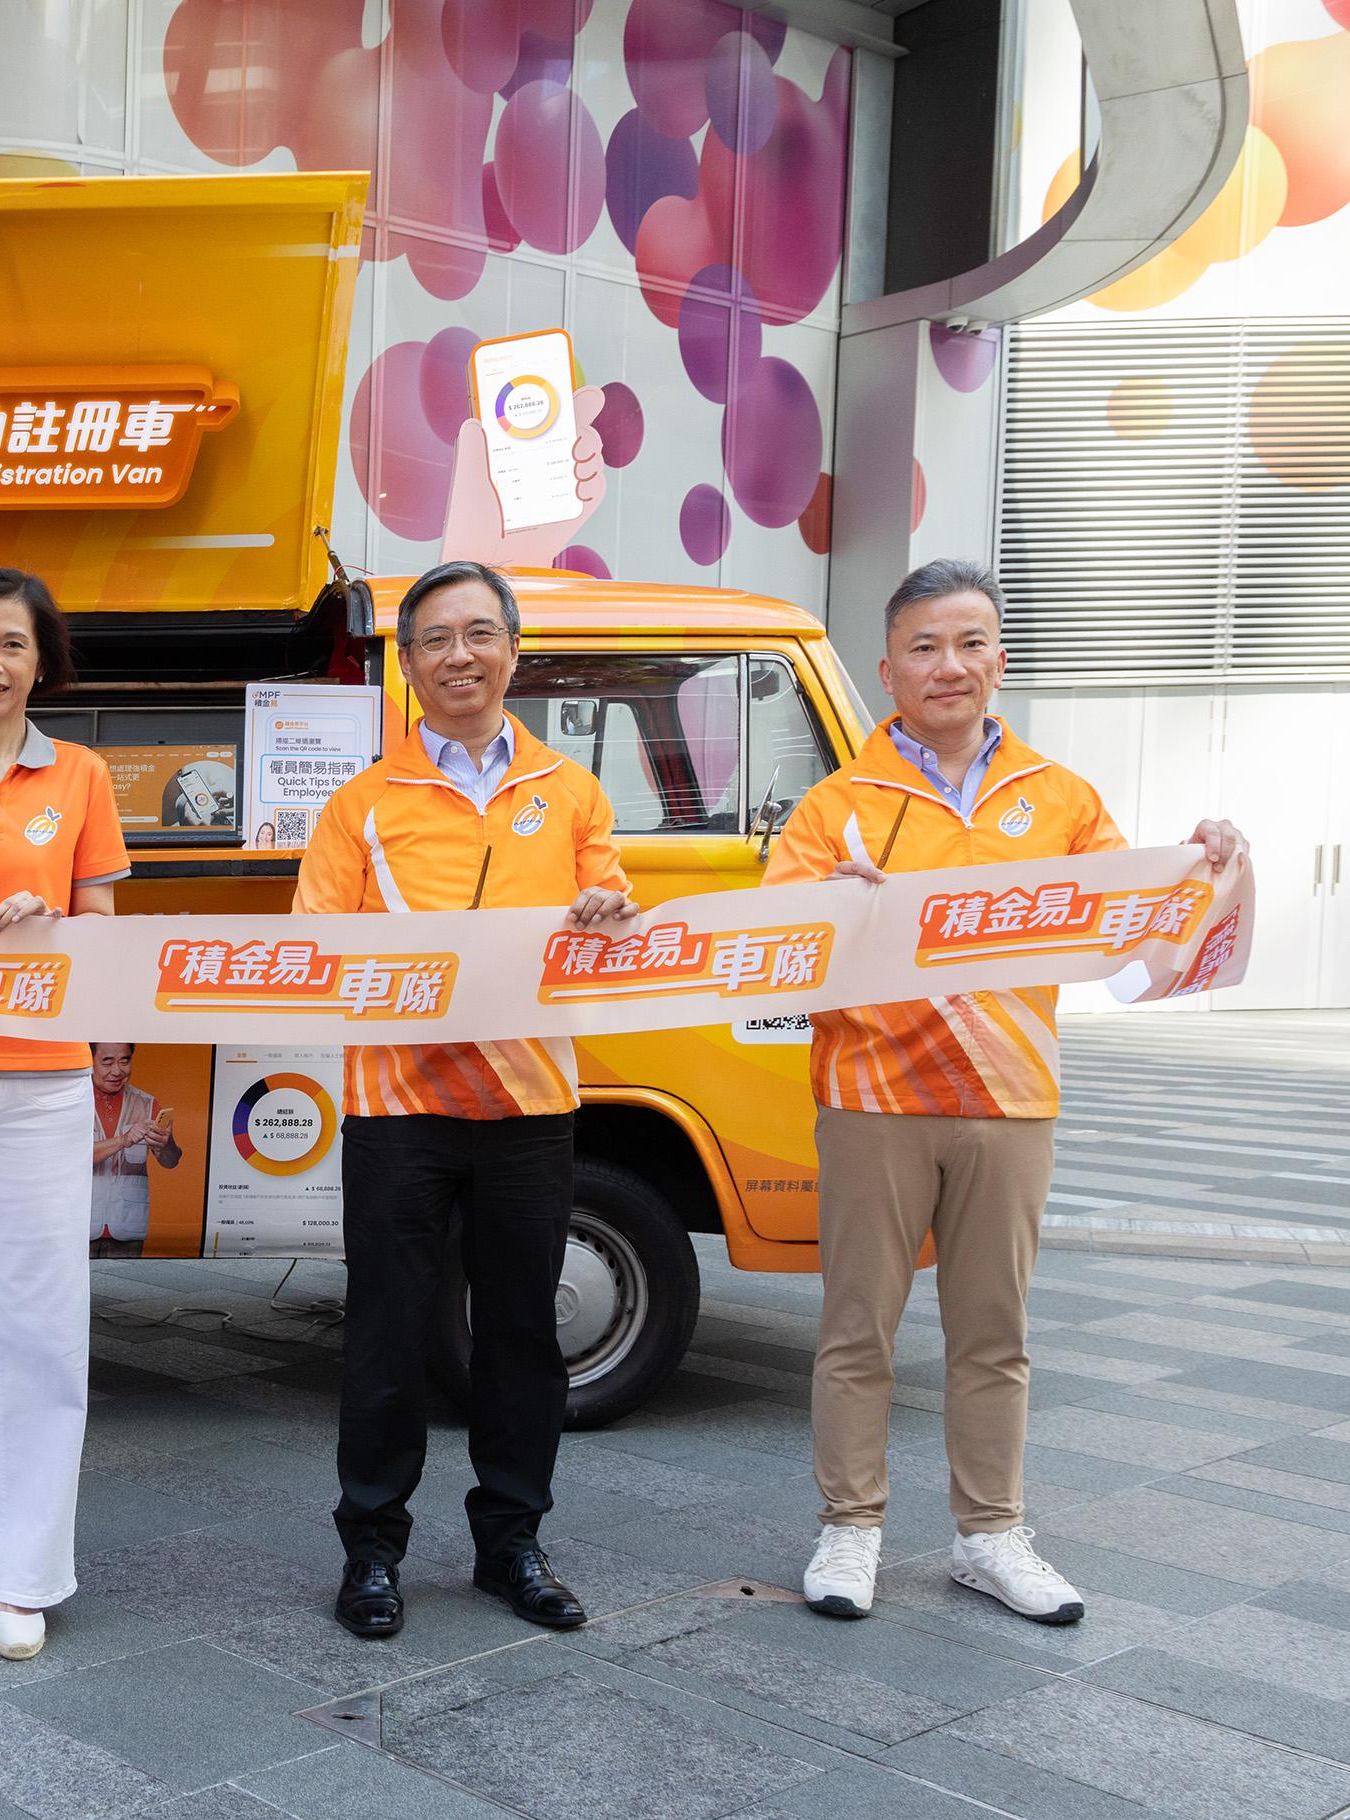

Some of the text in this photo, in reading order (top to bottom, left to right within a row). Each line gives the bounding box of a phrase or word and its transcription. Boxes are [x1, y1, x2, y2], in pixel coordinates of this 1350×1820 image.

[111, 464, 163, 485] Van
[270, 760, 356, 775] 僱員簡易指南
[277, 777, 346, 787] Quick Tips for
[548, 927, 825, 990] 「積金易」車隊
[163, 944, 451, 1013] 「積金易」車隊
[255, 1118, 313, 1128] $ 262,888.28
